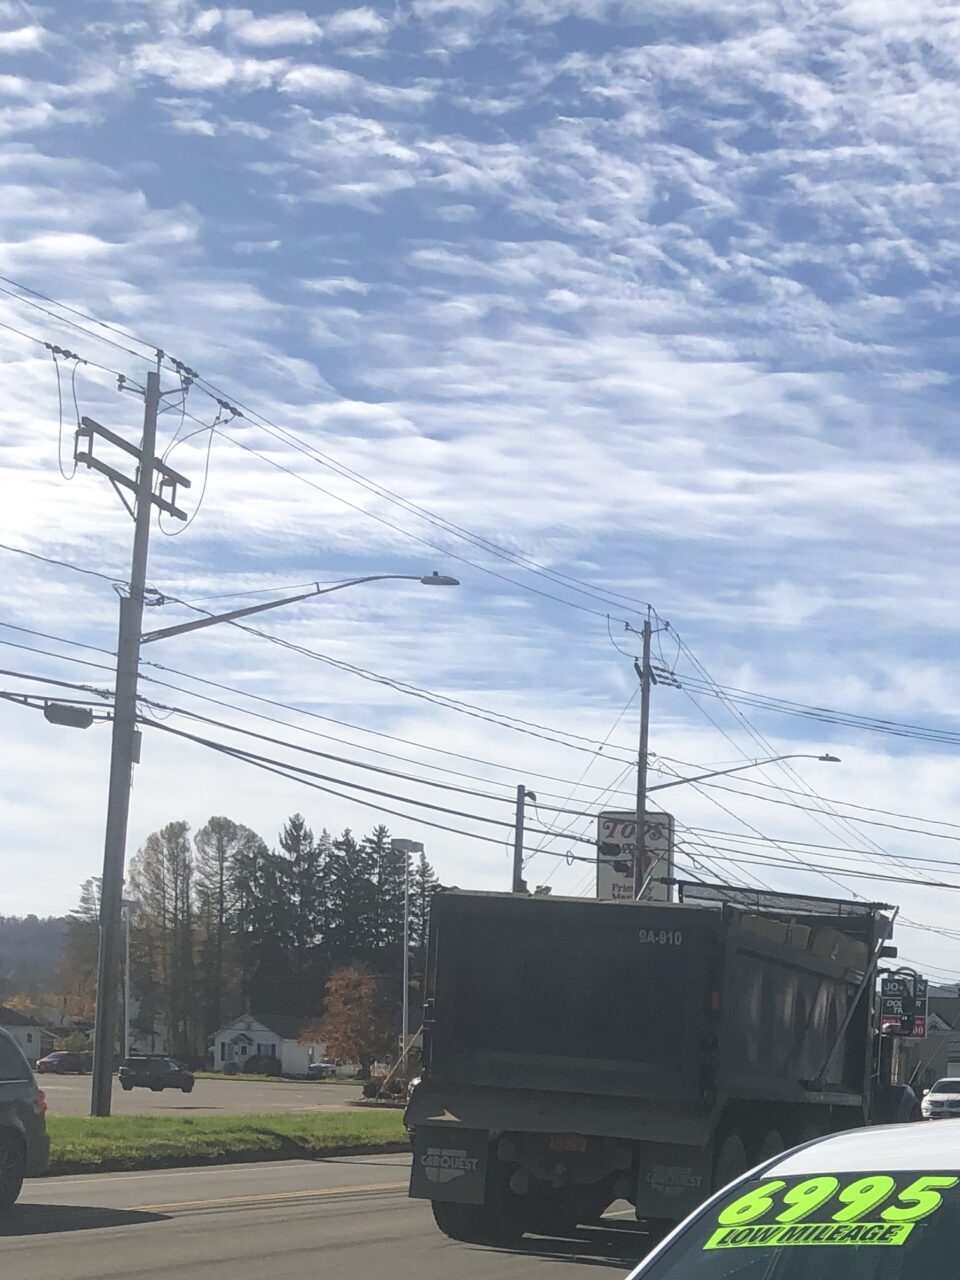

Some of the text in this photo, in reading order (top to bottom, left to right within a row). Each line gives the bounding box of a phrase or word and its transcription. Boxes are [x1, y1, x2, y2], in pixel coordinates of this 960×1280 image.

[717, 1175, 960, 1226] 6995
[715, 1223, 905, 1247] LOW MILEAGE
